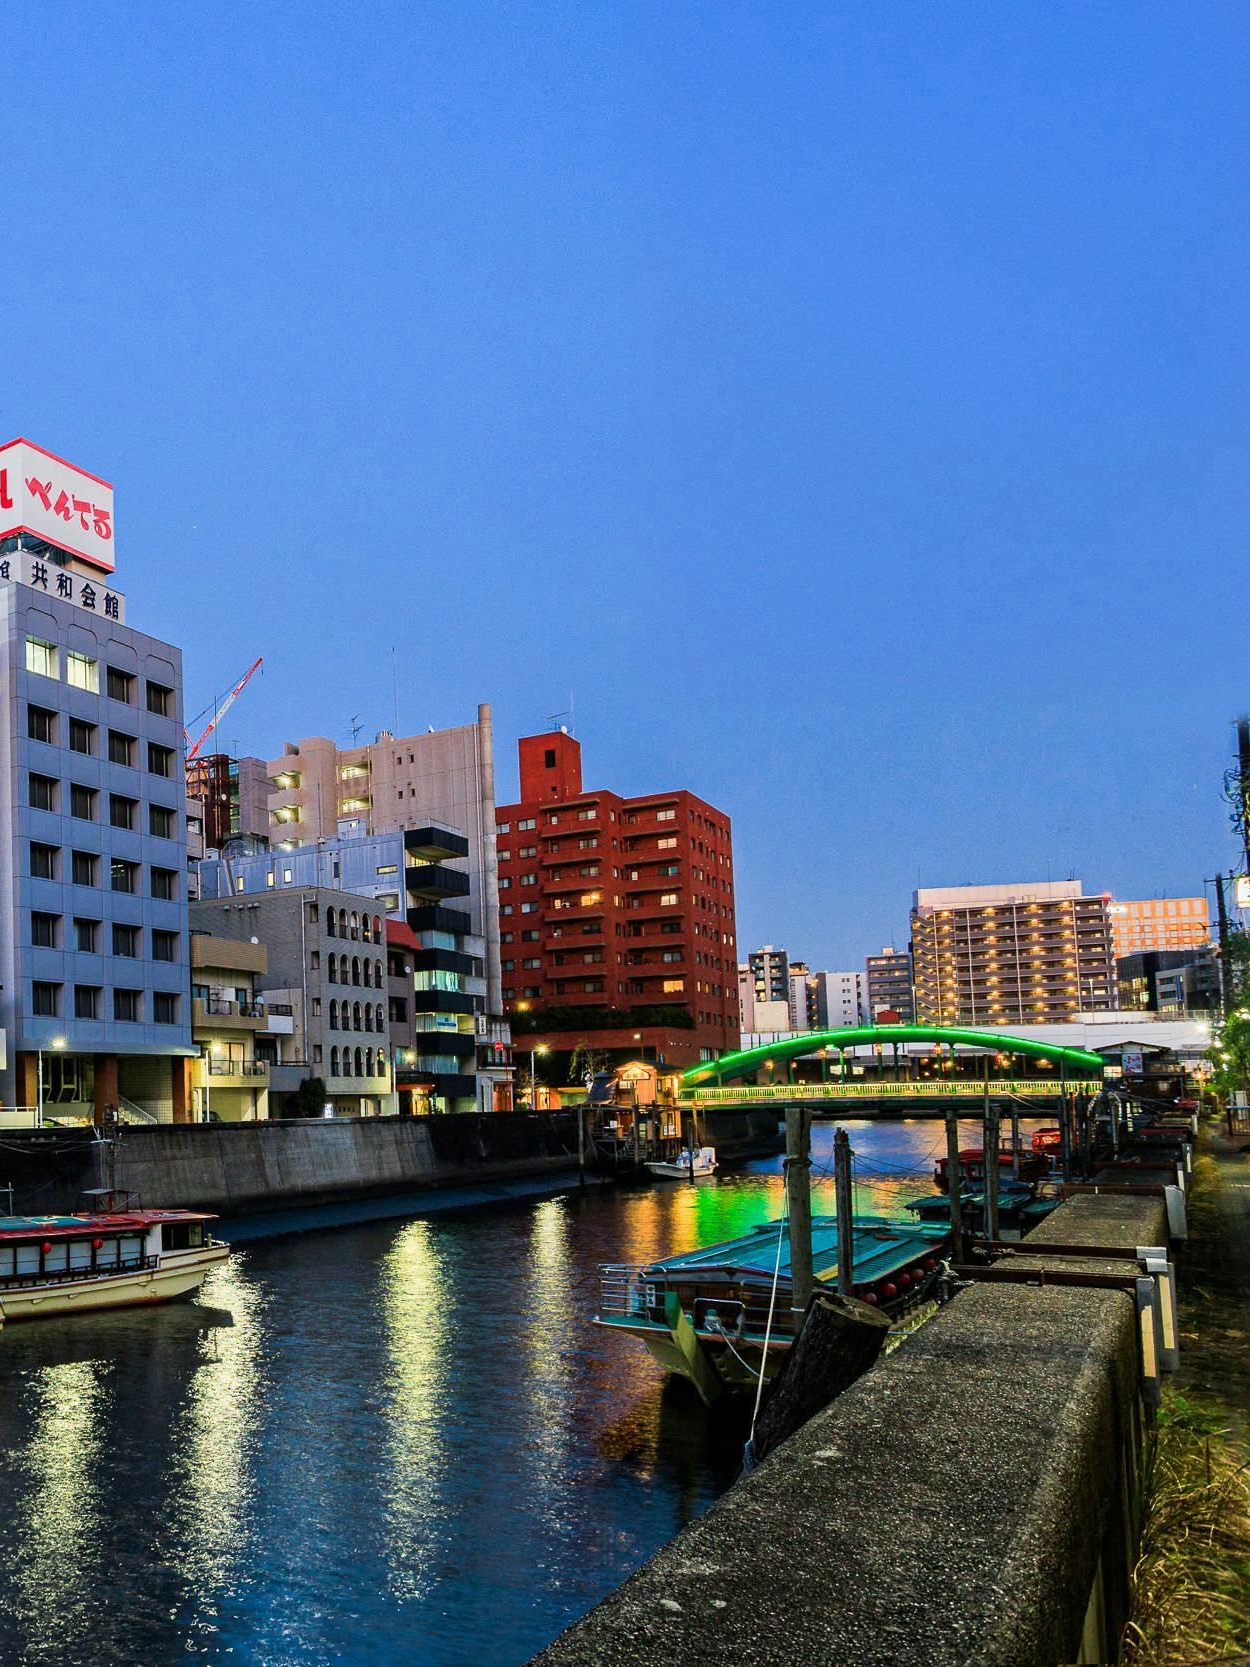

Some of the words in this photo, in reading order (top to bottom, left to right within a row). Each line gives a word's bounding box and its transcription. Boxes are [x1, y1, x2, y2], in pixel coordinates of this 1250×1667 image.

[24, 477, 112, 540] ぺんてる
[31, 561, 119, 620] 共和会館
